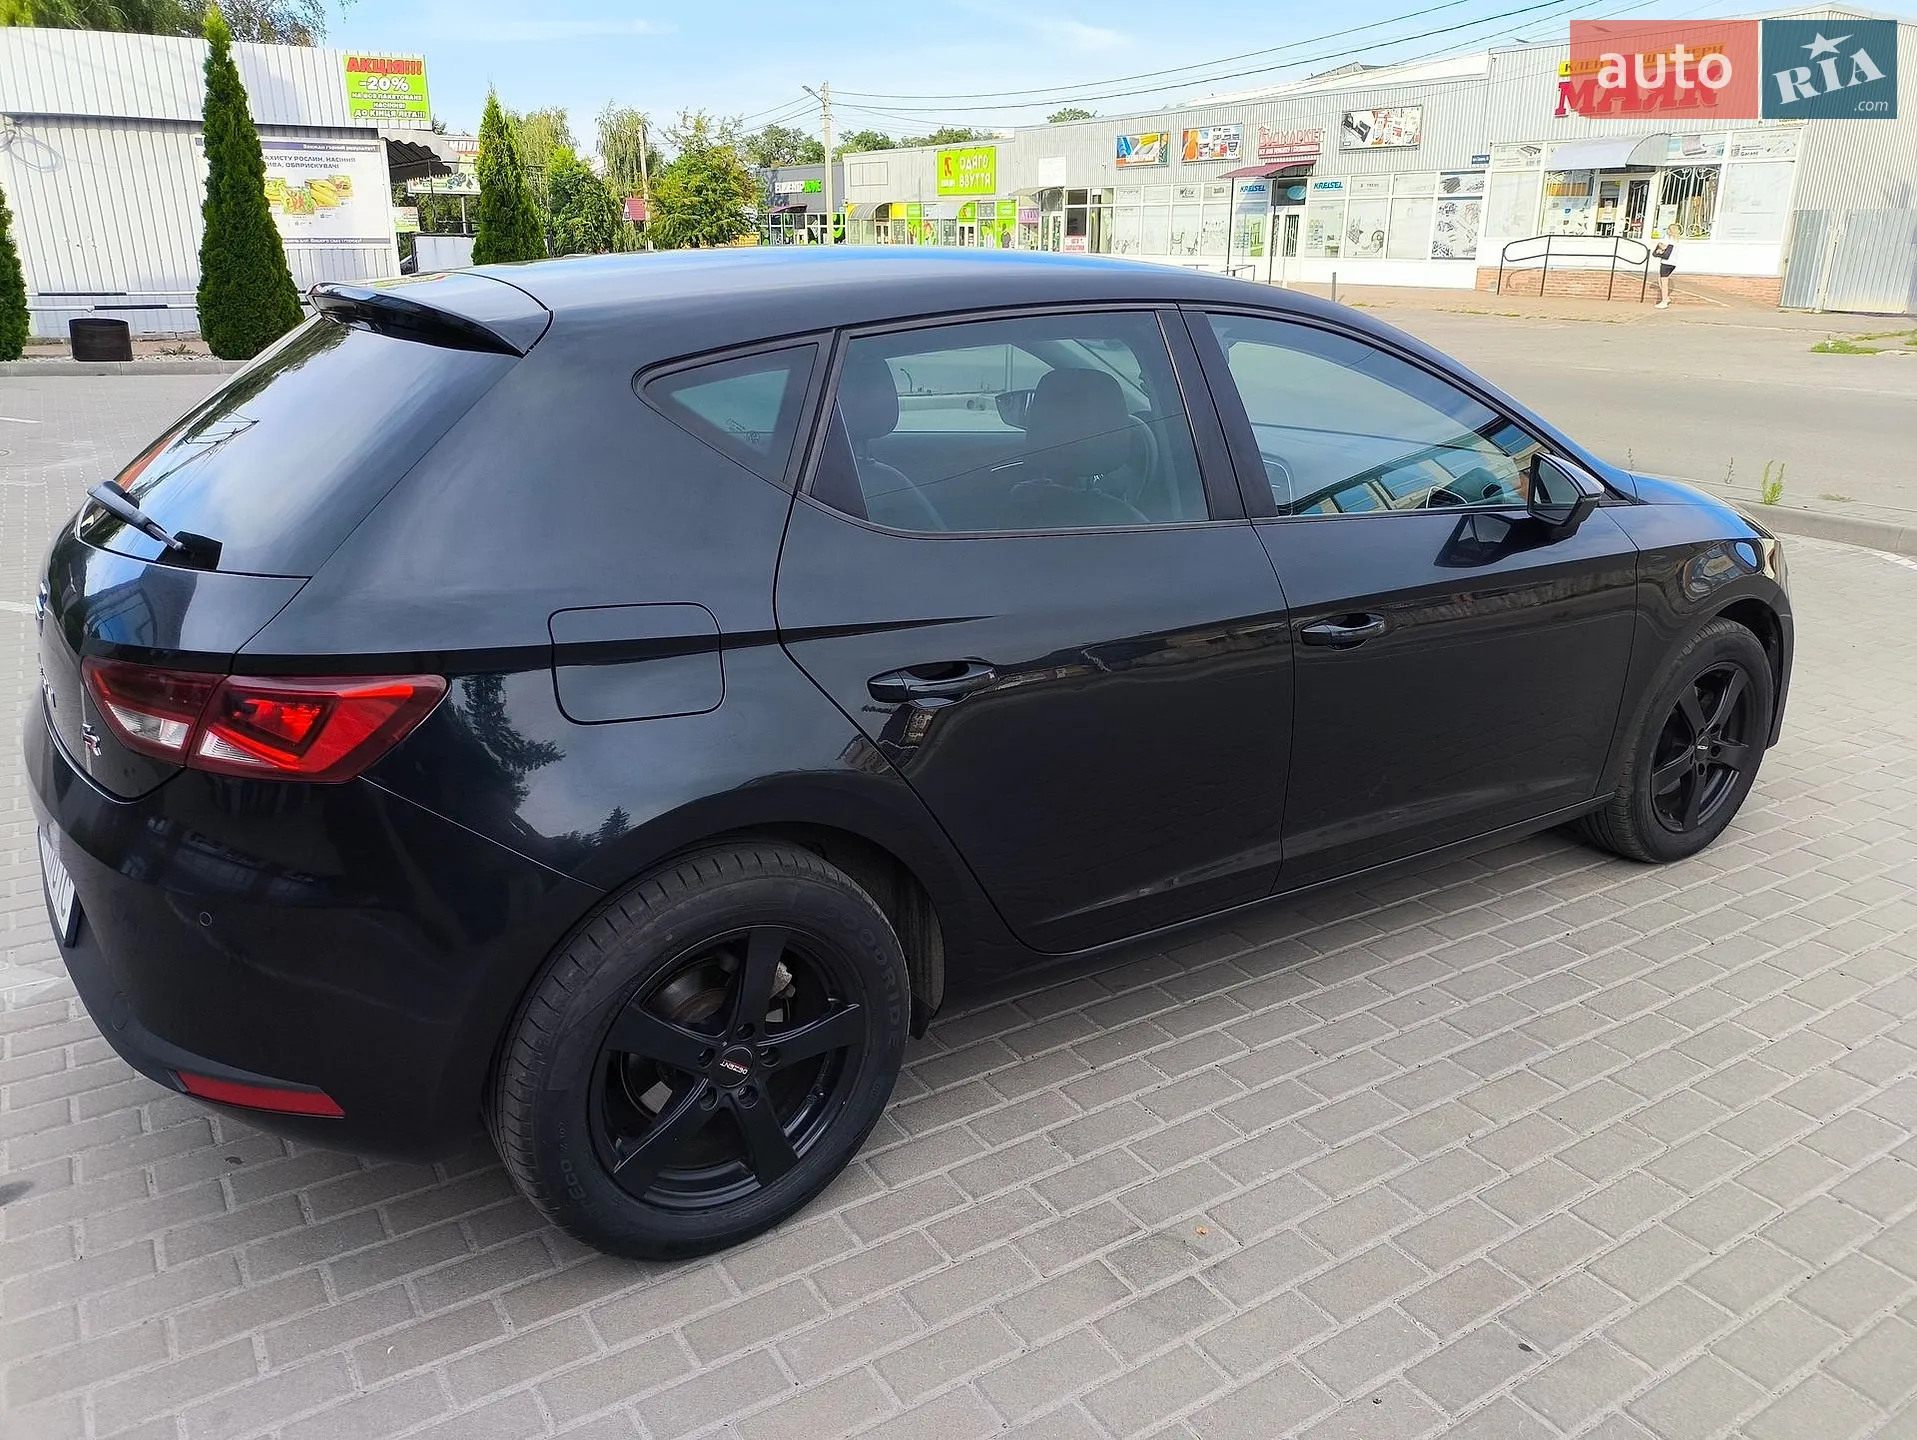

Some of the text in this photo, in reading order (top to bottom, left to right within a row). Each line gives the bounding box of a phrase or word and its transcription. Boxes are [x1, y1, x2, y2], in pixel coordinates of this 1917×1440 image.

[346, 57, 422, 76] АКЦІЯ!!!
[358, 76, 409, 92] -20%
[354, 109, 368, 117] ДО
[370, 109, 397, 118] КІНЦЯ
[960, 172, 991, 188] ВЗУТТЯ
[1313, 181, 1343, 189] KREISEL
